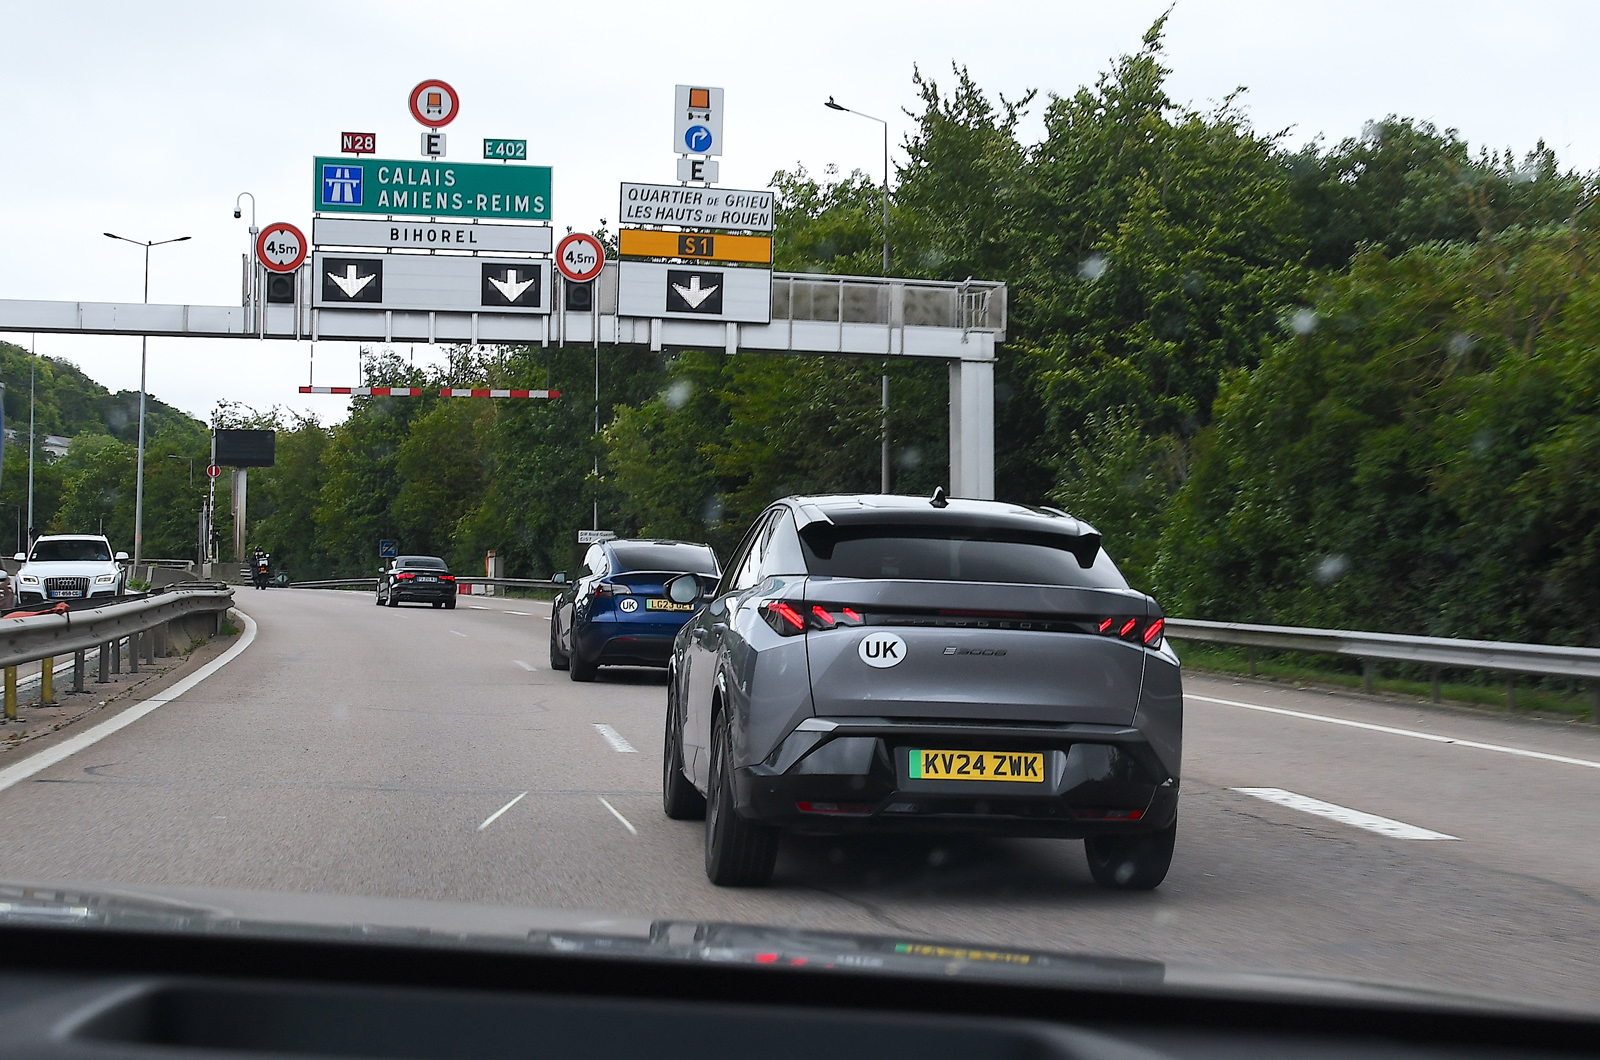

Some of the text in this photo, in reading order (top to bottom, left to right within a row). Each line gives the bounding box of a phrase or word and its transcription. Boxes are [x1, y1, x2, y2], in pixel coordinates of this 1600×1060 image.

[343, 135, 374, 150] N28
[427, 134, 441, 155] E
[377, 167, 456, 186] CALAIS
[691, 160, 705, 181] E
[378, 190, 545, 213] AMIENS-REIMS
[628, 188, 770, 209] QUARTIER DE GRIEU
[627, 205, 770, 226] LES HAUTS DE ROUEN
[390, 228, 478, 243] BIHOREL
[622, 601, 635, 610] UK
[865, 641, 898, 658] UK
[925, 753, 1038, 777] KV24 ZWK
